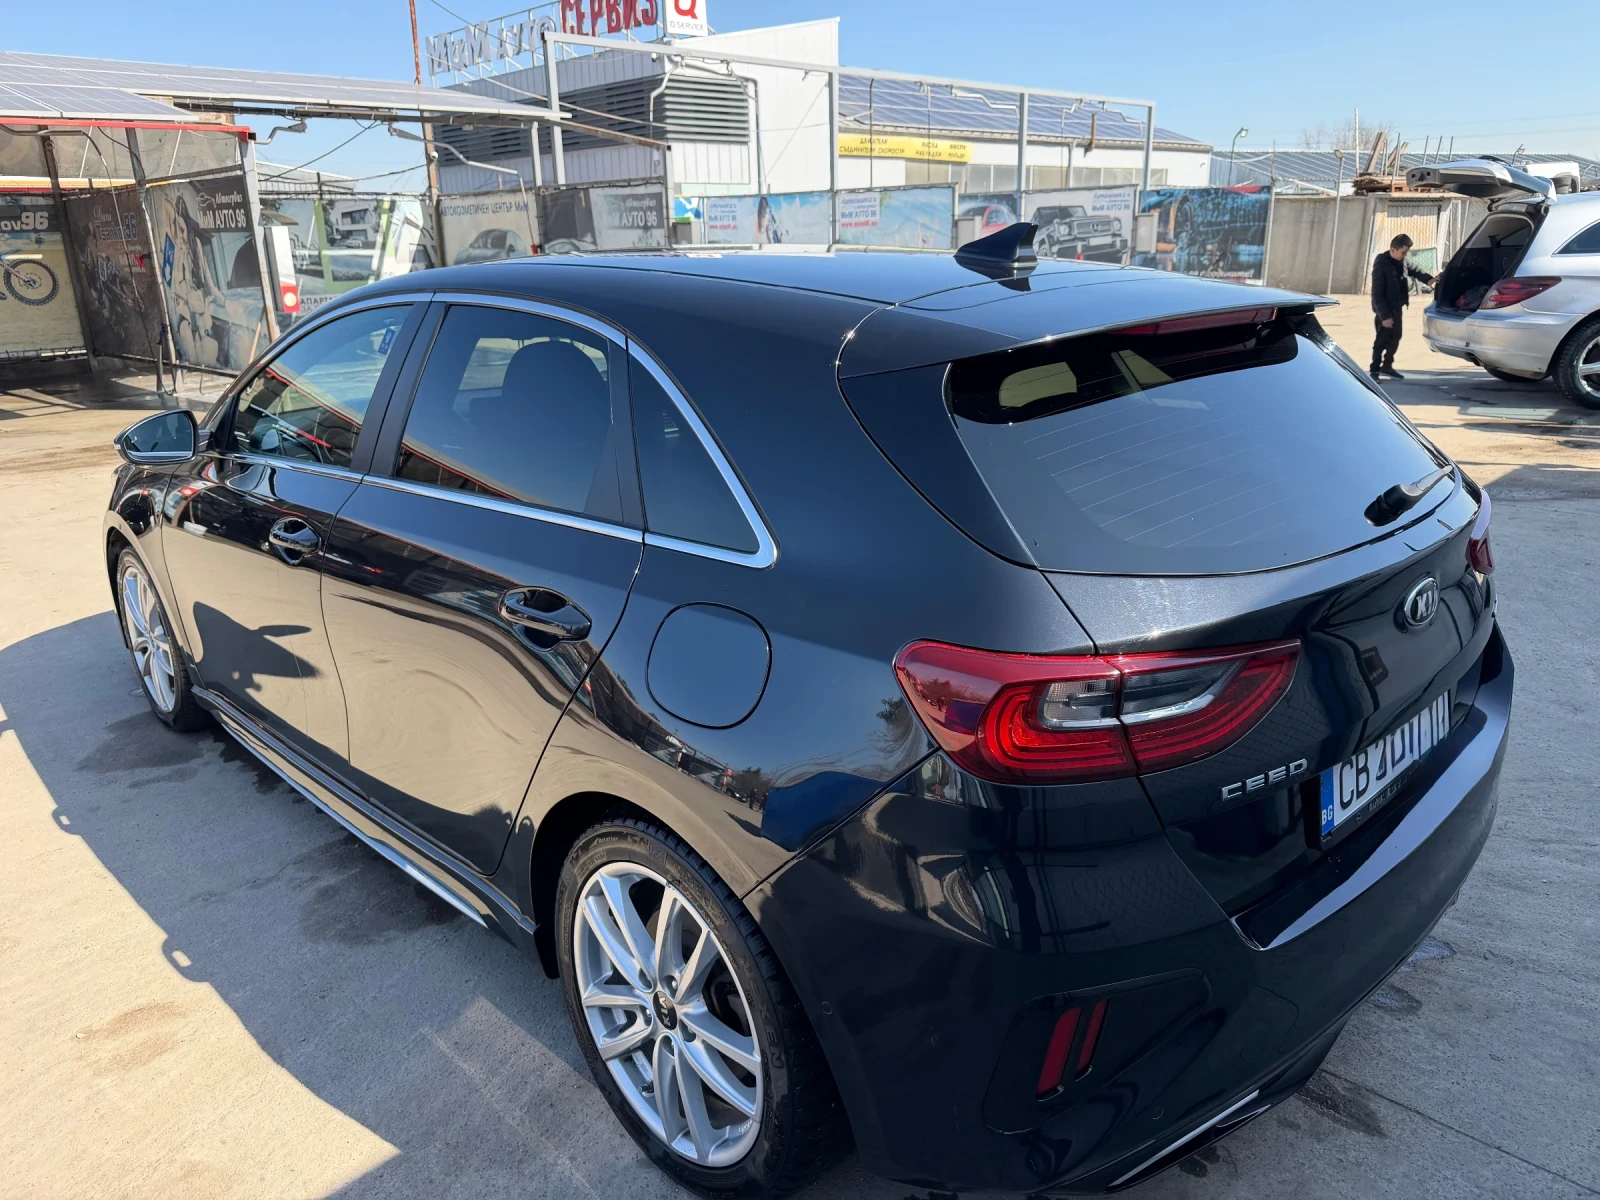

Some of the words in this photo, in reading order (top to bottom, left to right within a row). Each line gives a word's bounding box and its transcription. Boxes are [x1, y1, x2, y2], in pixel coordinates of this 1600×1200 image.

[0, 211, 49, 231] ov96
[216, 209, 235, 228] АУТО
[236, 208, 247, 228] 96
[621, 211, 645, 227] АУТО
[646, 209, 657, 227] 96
[1220, 758, 1308, 801] CEED
[1321, 804, 1334, 826] BG
[659, 996, 672, 1027] KIA
